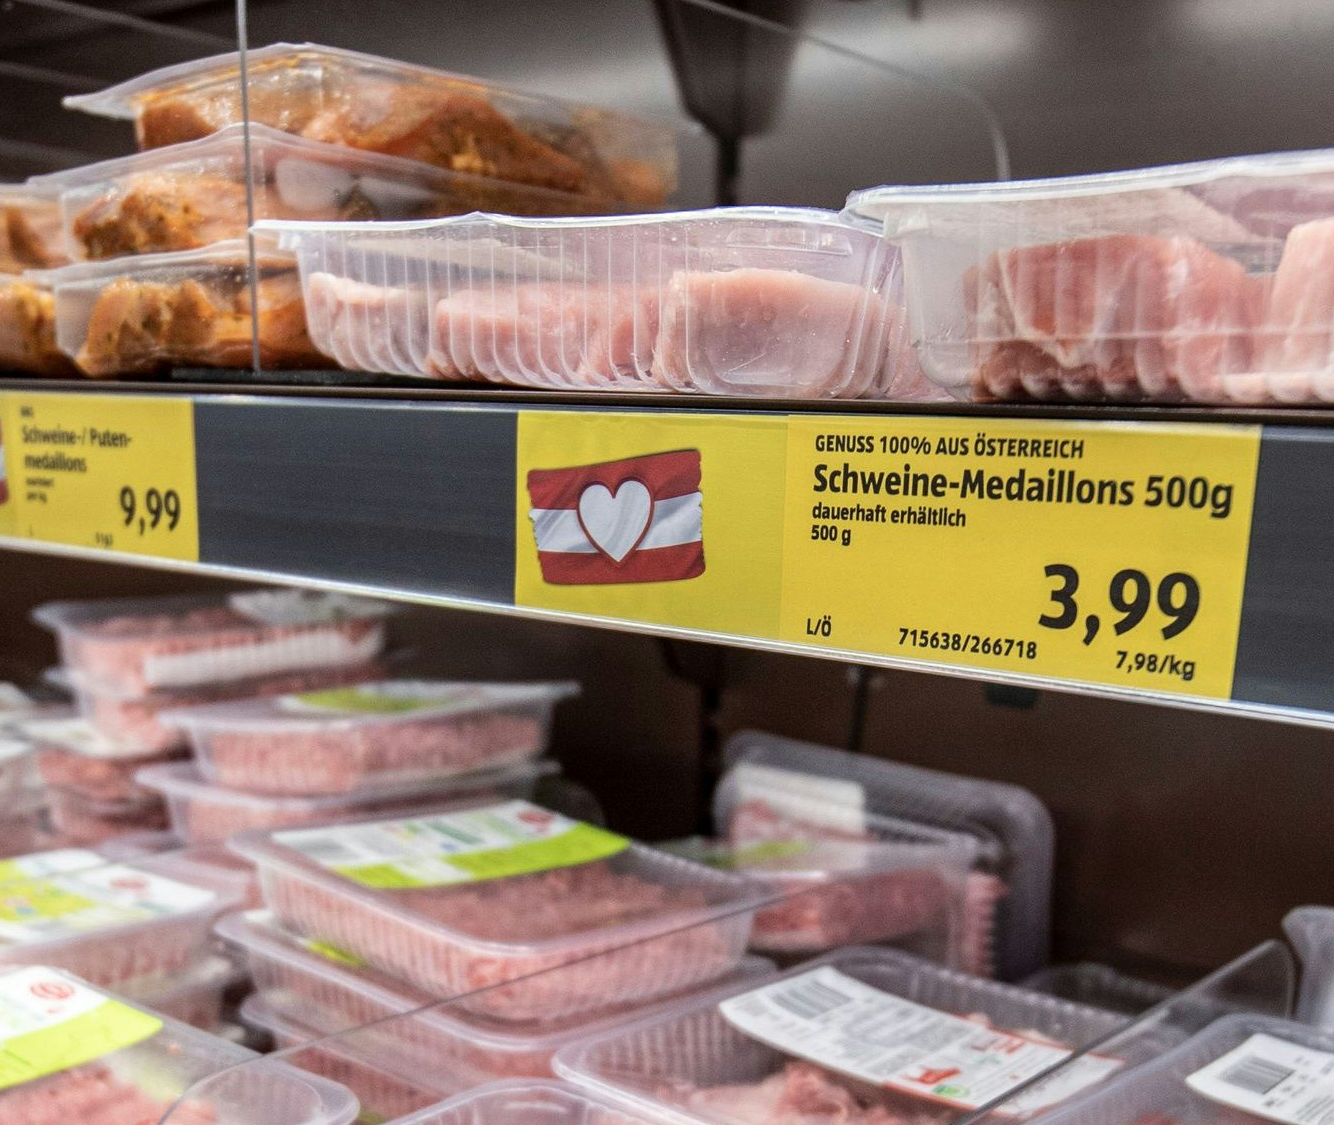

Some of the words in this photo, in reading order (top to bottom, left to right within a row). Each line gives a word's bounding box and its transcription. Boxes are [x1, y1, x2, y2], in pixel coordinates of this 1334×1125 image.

[815, 434, 875, 453] GENUSS
[880, 436, 931, 455] 100%
[935, 437, 969, 456] AUS
[974, 432, 1084, 459] ÖSTERREICH
[813, 462, 1135, 507] Schweine-Medaillons
[1144, 475, 1233, 519] 500g
[119, 485, 181, 536] 9,99
[812, 501, 887, 523] dauerhaft
[890, 505, 966, 527] erhältlich
[811, 524, 838, 541] 500
[841, 528, 852, 546] g
[1038, 563, 1201, 646] 3,99
[806, 615, 832, 637] L/Ö
[898, 627, 1038, 659] 715638/266718
[1115, 650, 1196, 681] 7,98/kg
